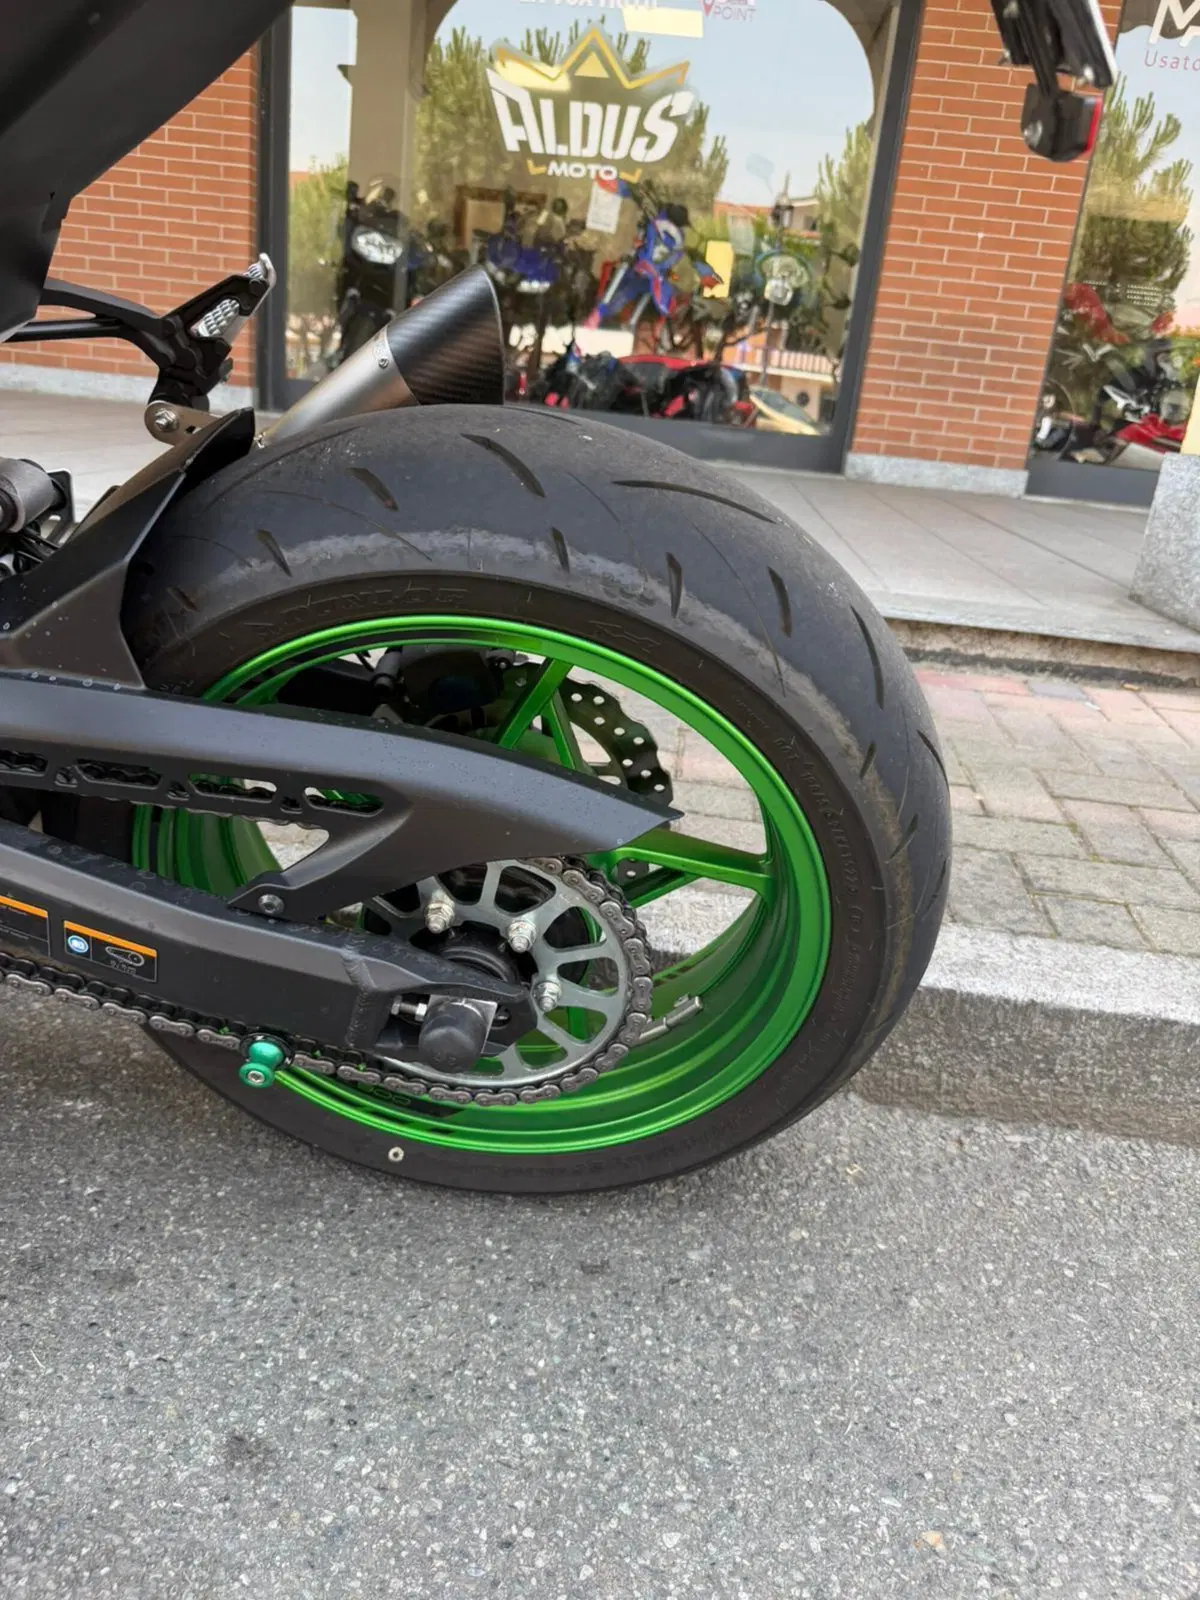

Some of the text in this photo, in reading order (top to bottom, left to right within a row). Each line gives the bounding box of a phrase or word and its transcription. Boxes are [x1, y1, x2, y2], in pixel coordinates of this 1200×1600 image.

[713, 5, 757, 22] POINT
[485, 67, 695, 163] ALDUS
[547, 160, 618, 181] MOTO
